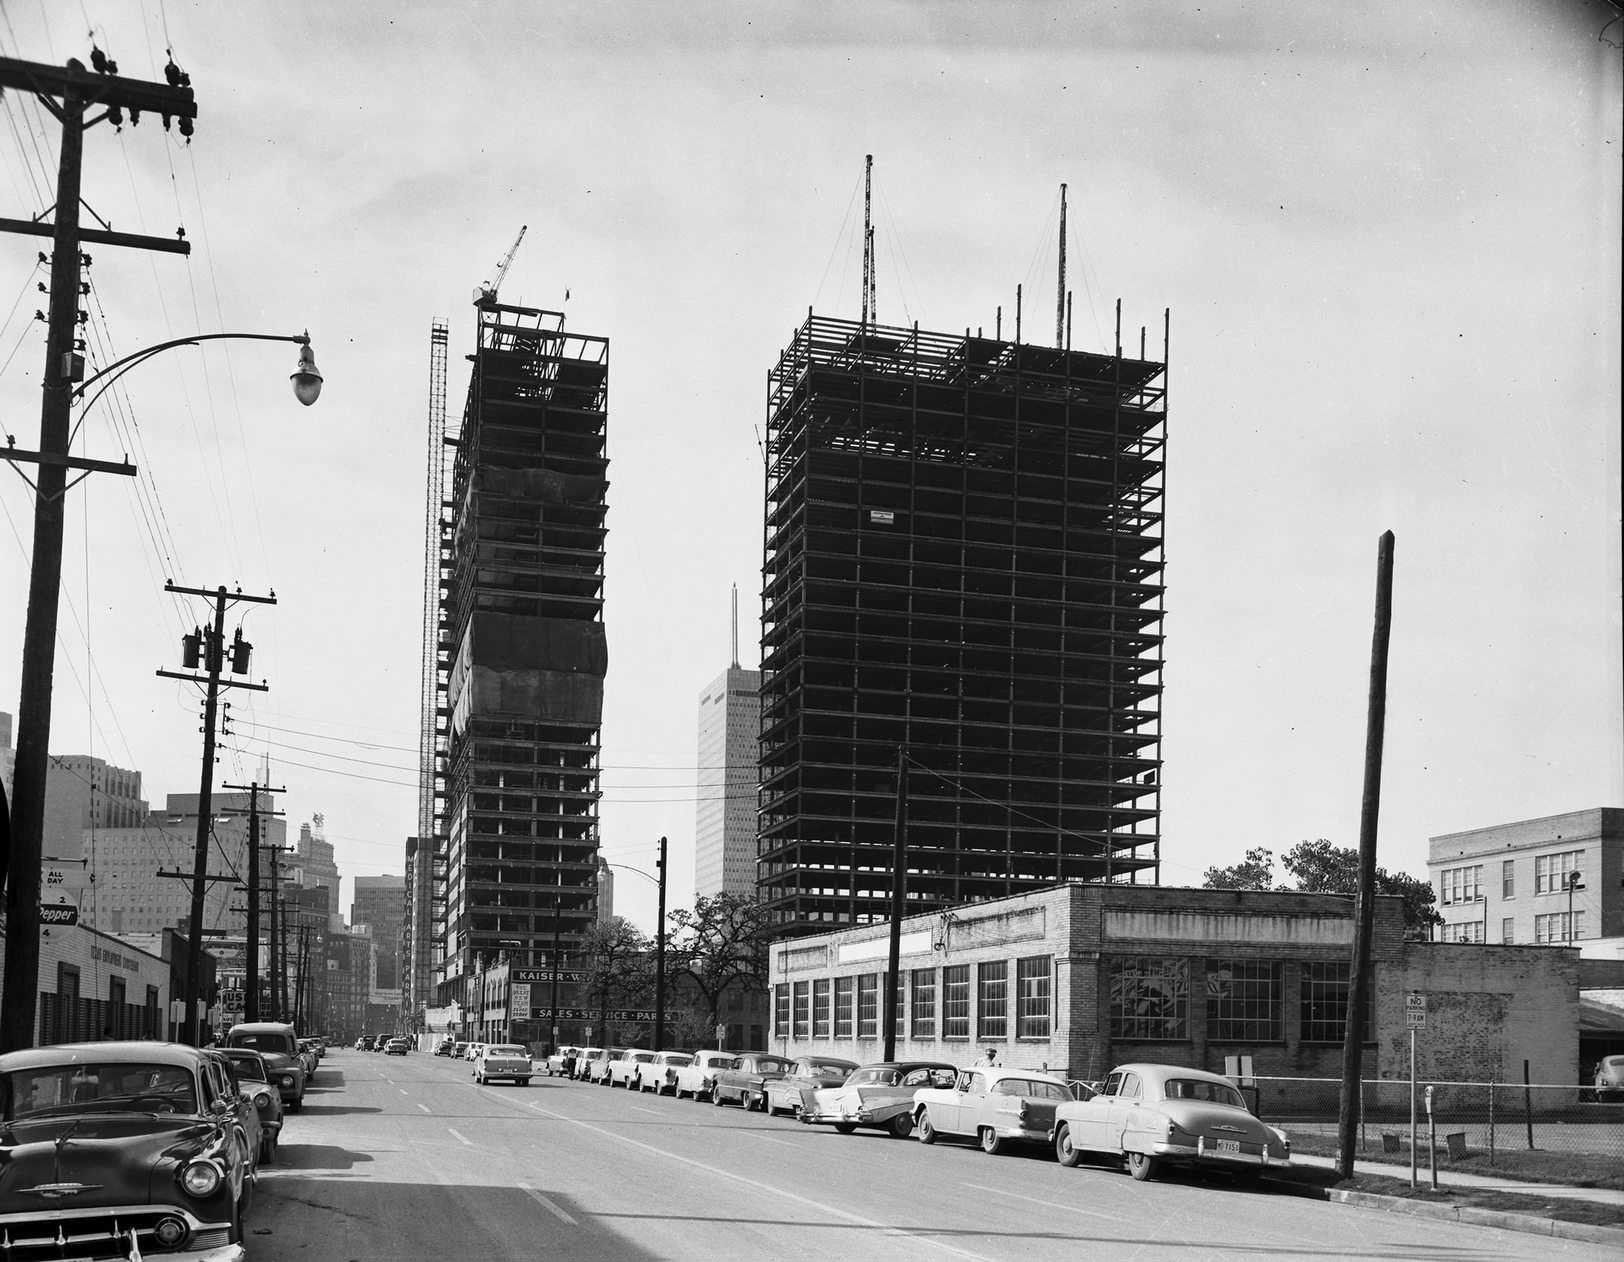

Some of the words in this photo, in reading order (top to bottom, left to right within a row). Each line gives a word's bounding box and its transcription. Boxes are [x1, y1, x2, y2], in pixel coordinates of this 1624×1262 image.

[406, 856, 414, 916] MEDICAL
[59, 896, 66, 904] 2
[42, 929, 50, 937] 4
[519, 971, 564, 981] KAISER
[636, 1011, 671, 1021] PARS
